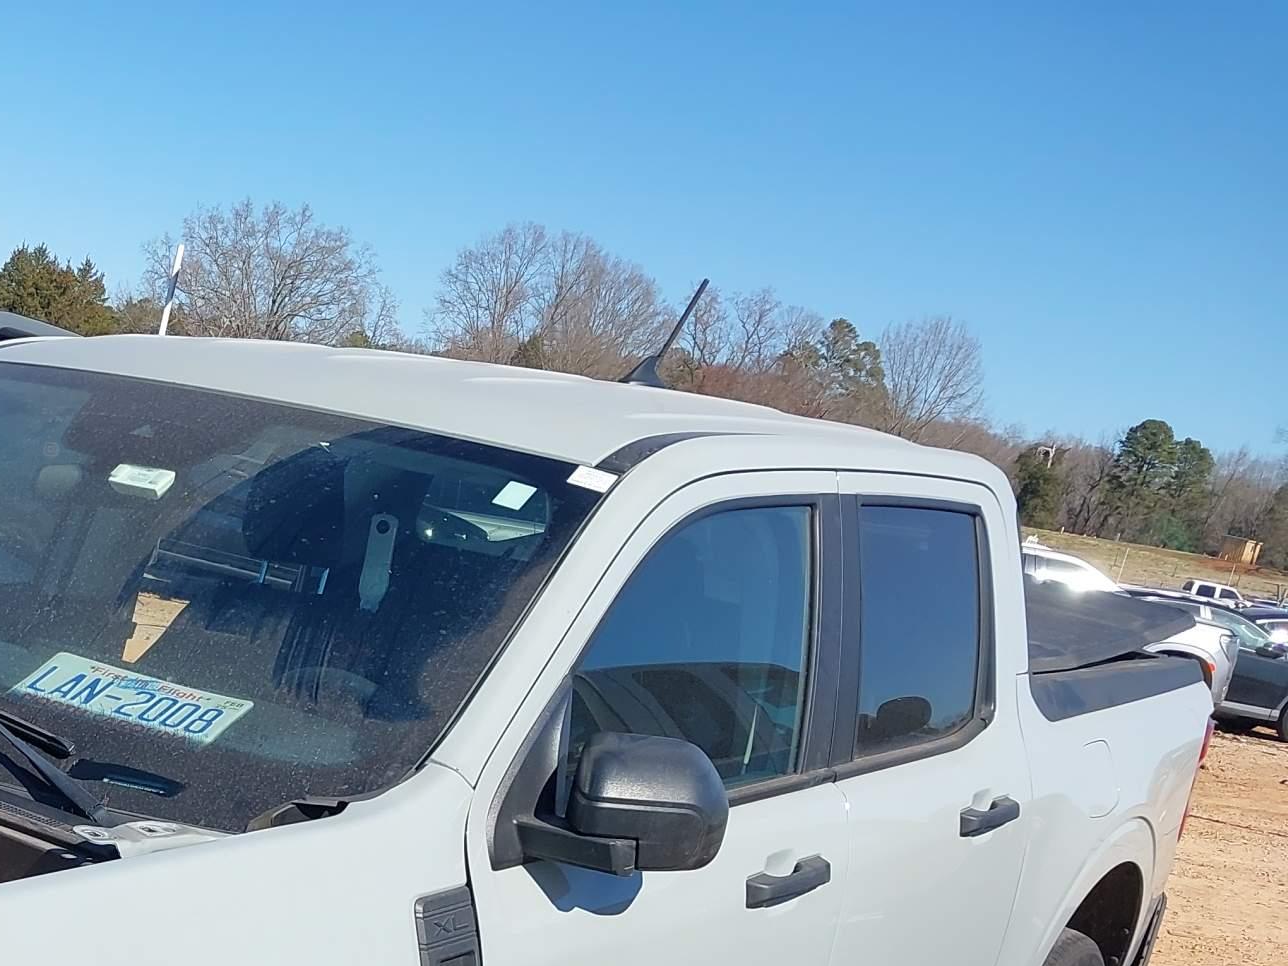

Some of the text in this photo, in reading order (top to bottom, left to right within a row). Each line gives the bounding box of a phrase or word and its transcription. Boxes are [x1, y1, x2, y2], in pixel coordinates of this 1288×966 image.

[27, 665, 225, 734] LAN-2008
[157, 684, 204, 702] Flight
[433, 915, 469, 937] XL
